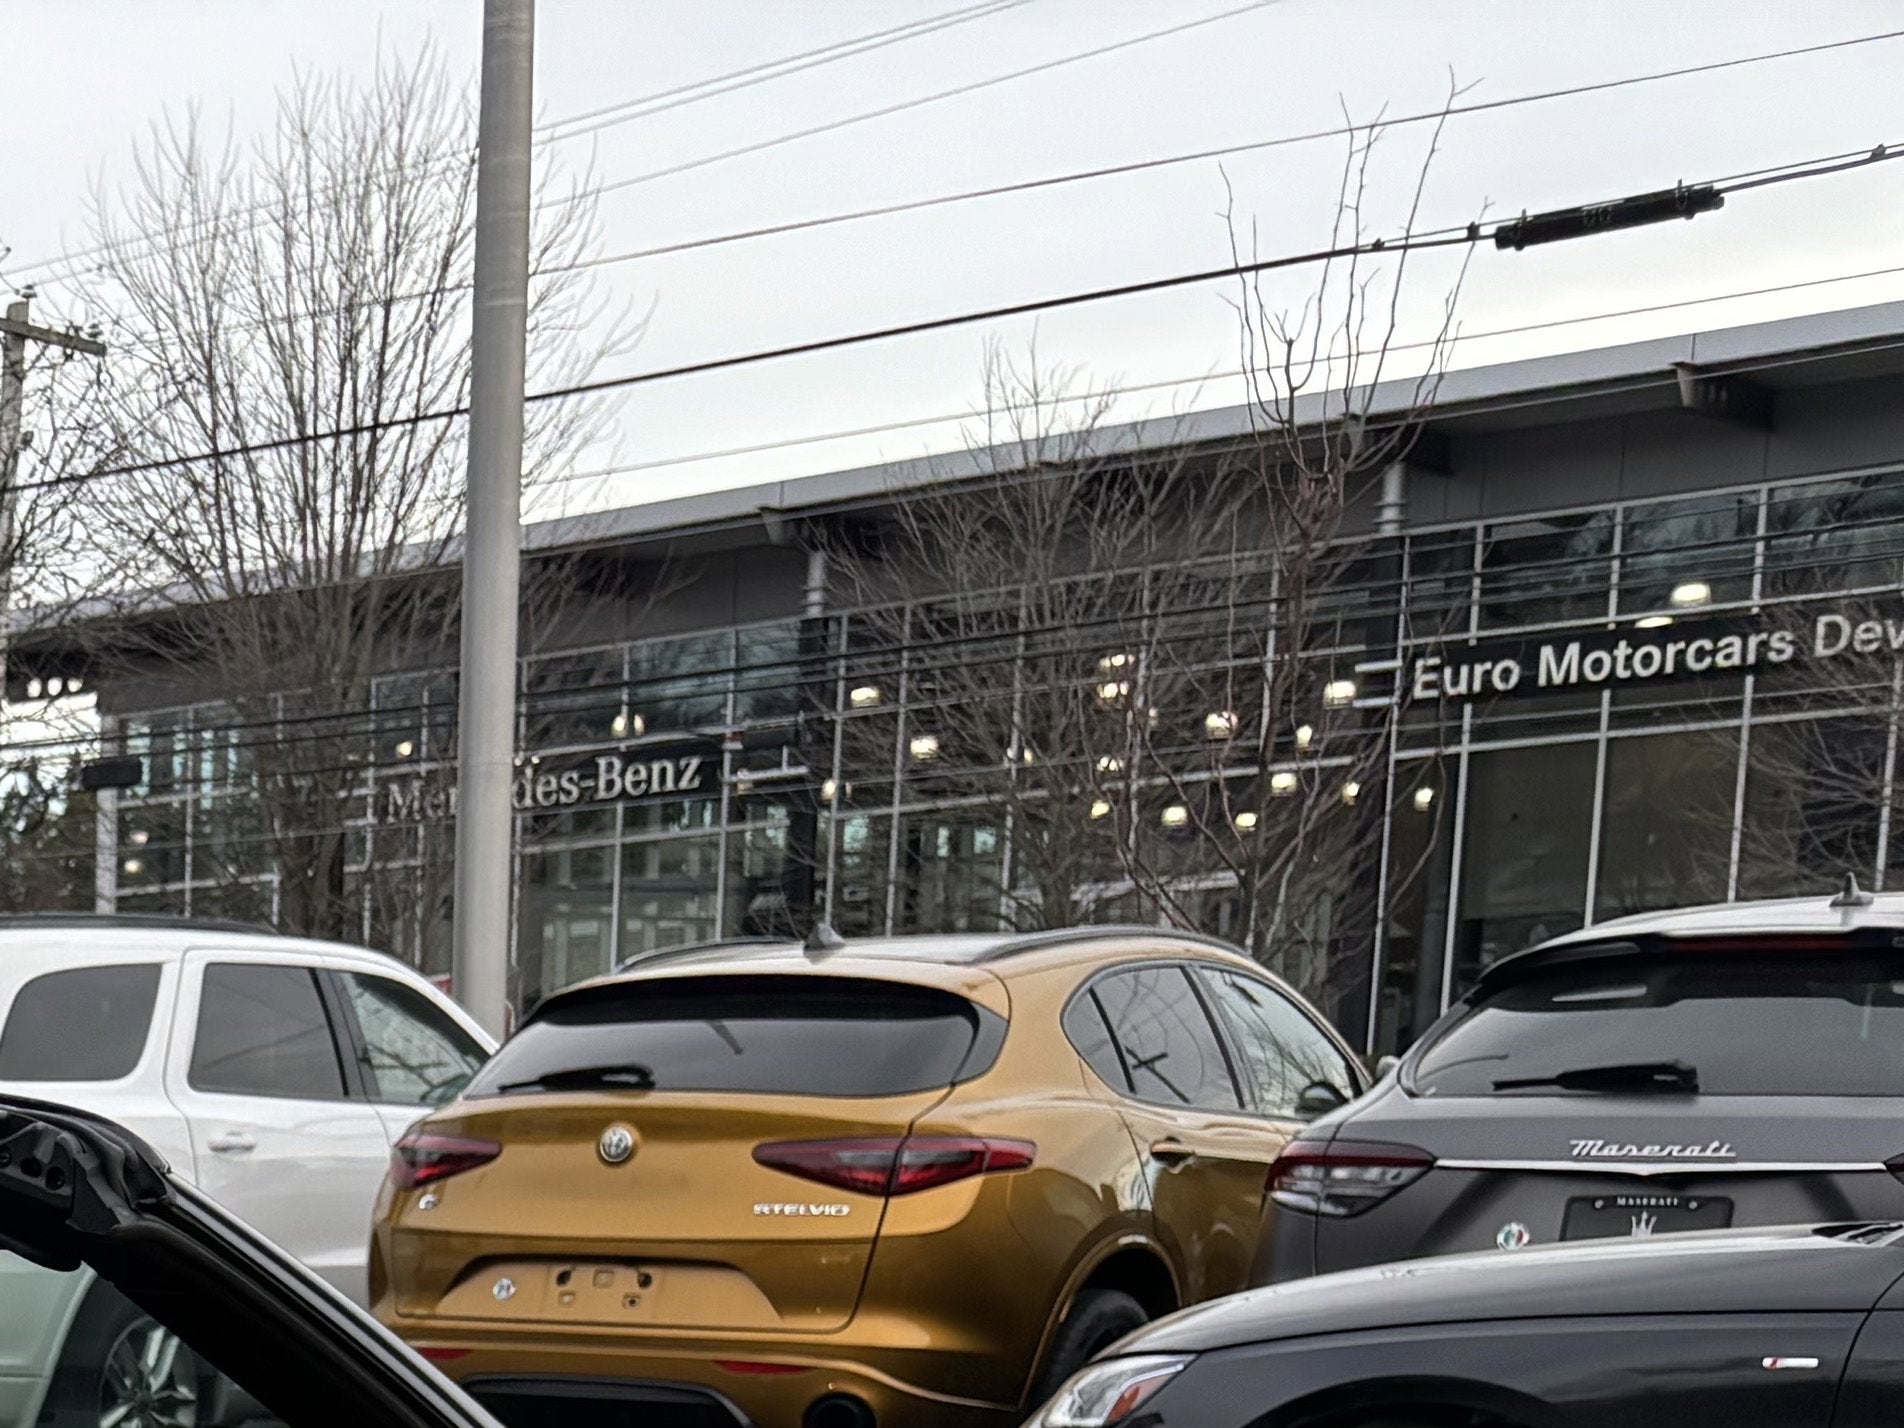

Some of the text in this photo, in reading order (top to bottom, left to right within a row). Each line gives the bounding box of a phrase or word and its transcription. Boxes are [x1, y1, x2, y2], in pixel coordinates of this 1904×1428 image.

[1413, 614, 1904, 700] Euro Motorcars Dev
[1569, 1139, 1737, 1158] Maserati
[1616, 1196, 1679, 1206] MASERATI
[753, 1203, 851, 1216] STELVIO
